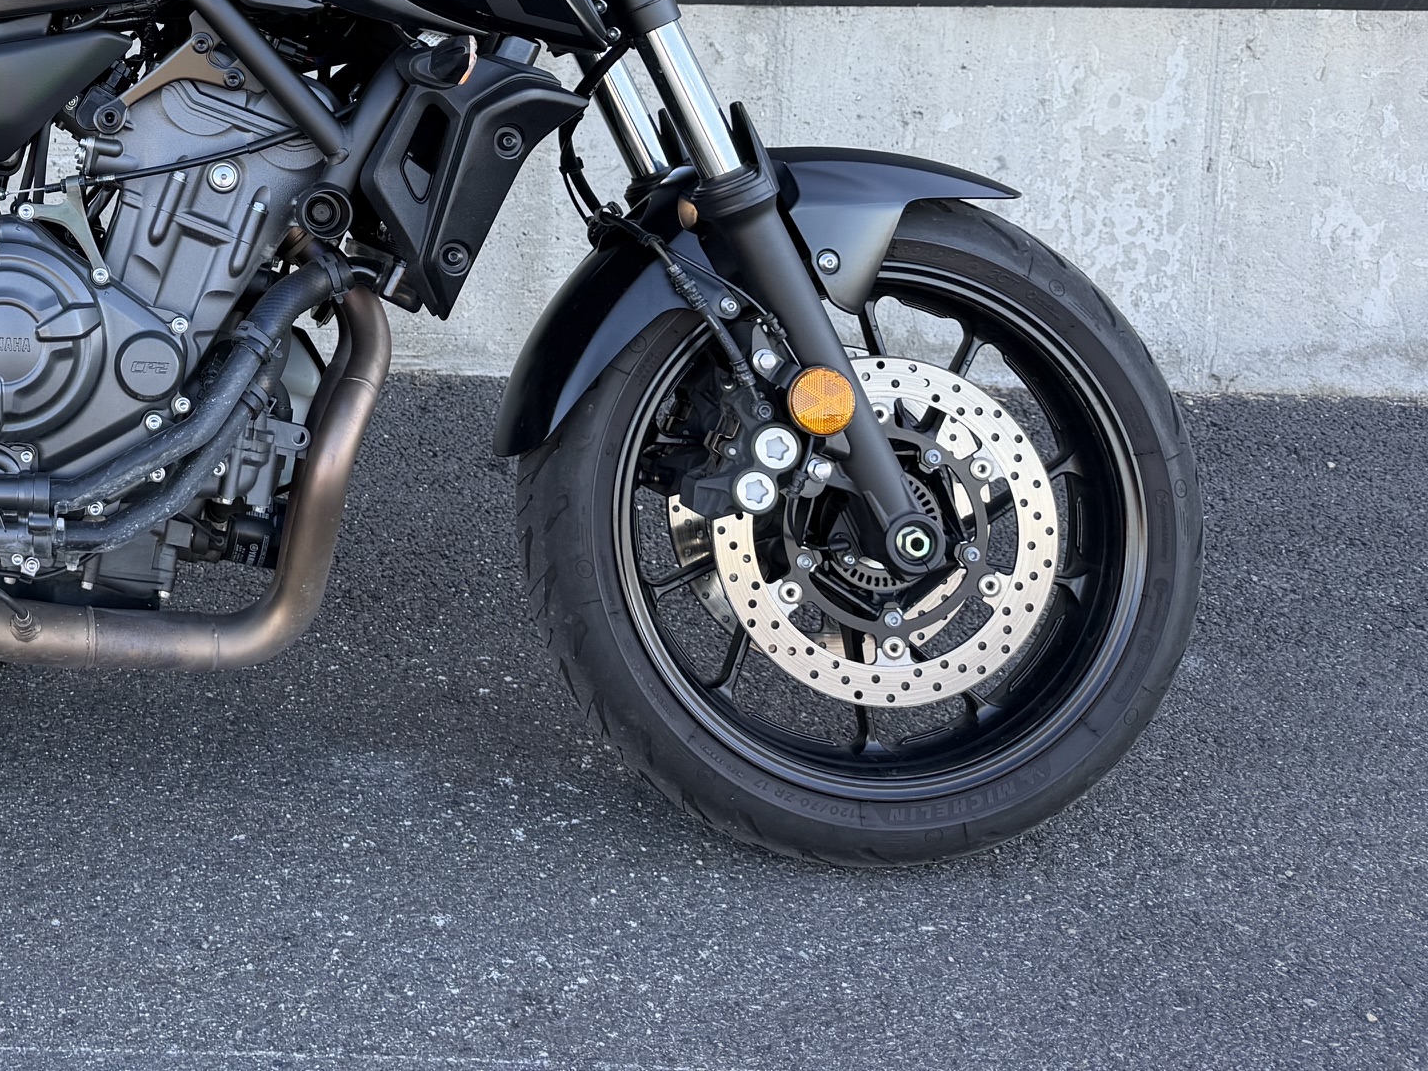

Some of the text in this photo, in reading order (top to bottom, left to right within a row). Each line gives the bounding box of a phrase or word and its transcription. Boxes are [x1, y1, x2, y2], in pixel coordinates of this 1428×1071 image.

[753, 778, 768, 791] 17
[774, 786, 797, 803] ZR
[889, 781, 1017, 821] MICHELIN
[800, 797, 857, 819] 120/70
